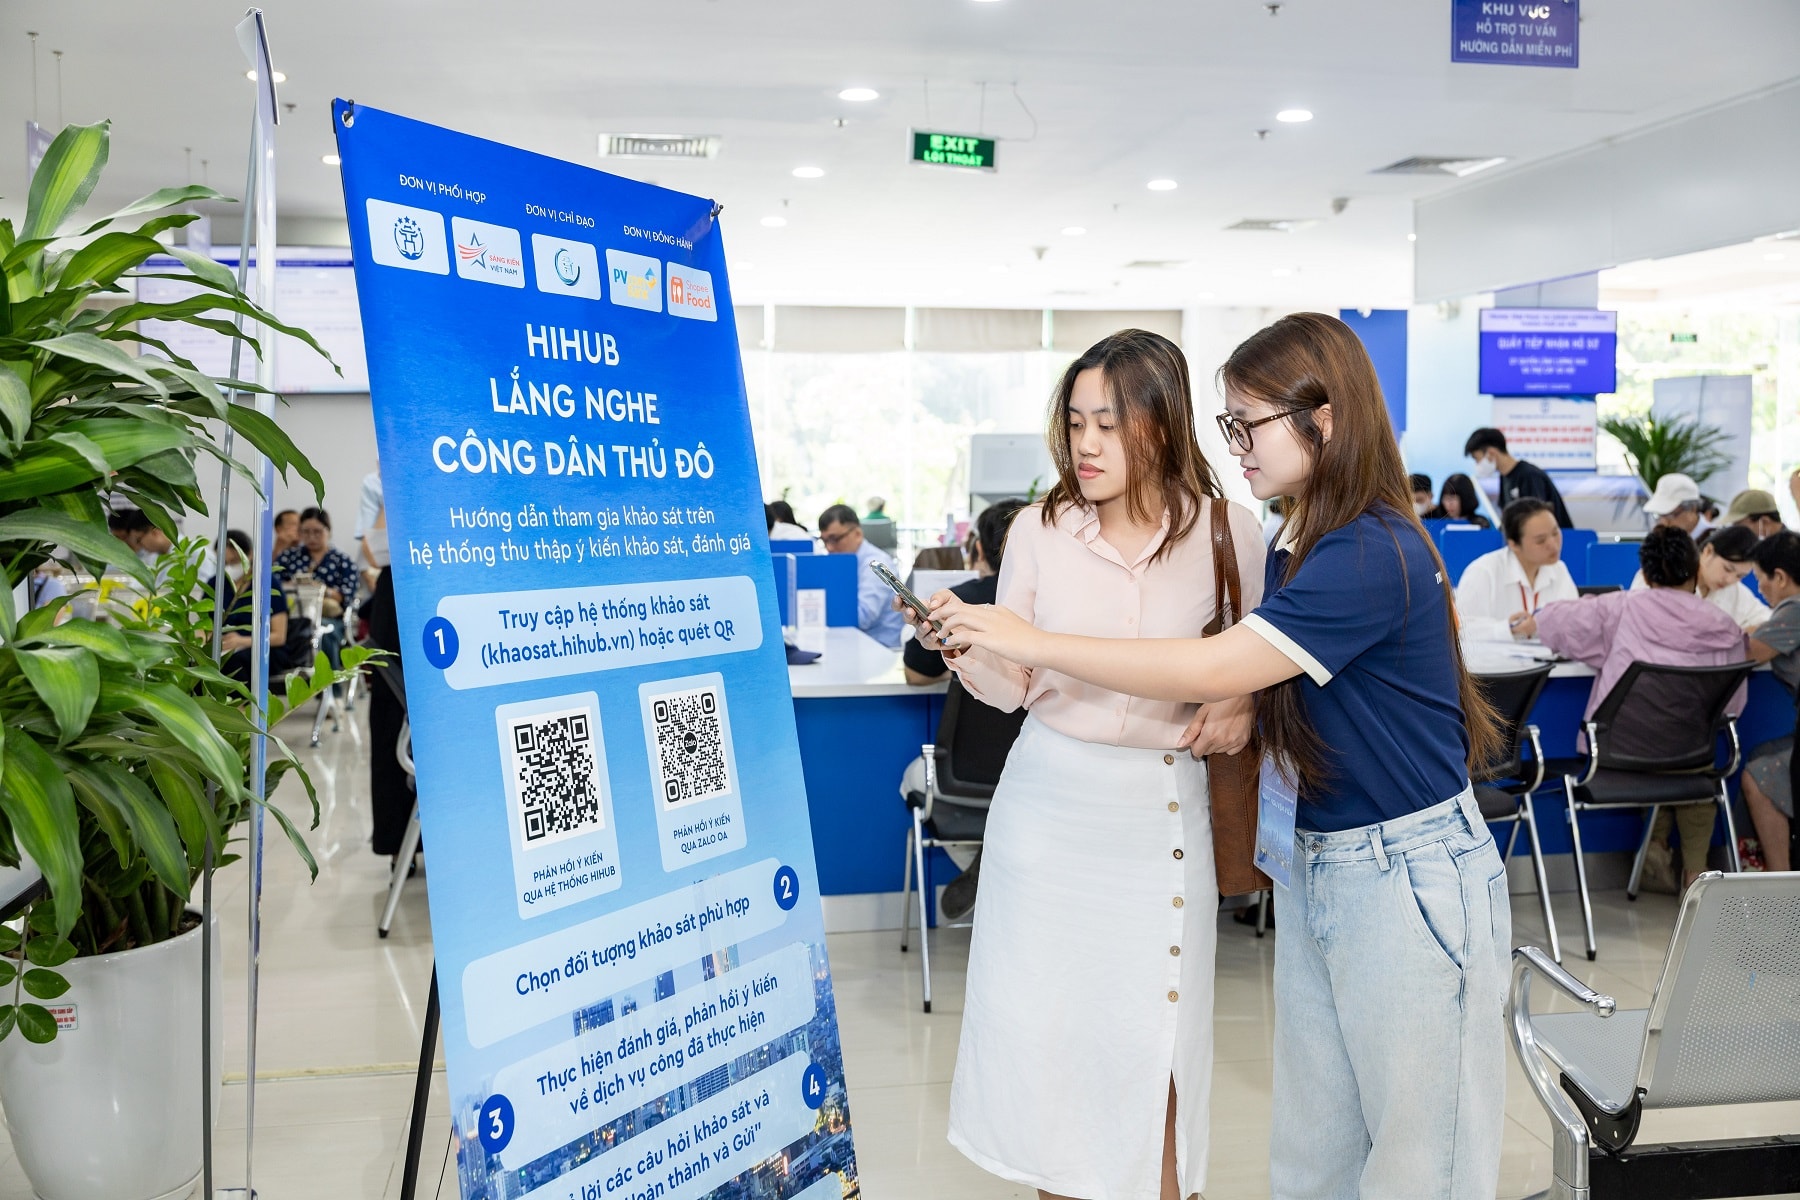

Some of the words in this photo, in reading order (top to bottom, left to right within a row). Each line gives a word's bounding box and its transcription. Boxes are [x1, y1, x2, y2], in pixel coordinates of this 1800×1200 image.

[1482, 3, 1514, 16] KHU
[1495, 22, 1516, 38] TRỢ
[1519, 24, 1534, 36] TƯ
[1535, 22, 1557, 37] VẤN
[1526, 40, 1552, 56] MIỄN
[1555, 43, 1572, 57] PHÍ
[930, 134, 979, 153] EXIT
[399, 174, 424, 190] ĐƠN
[426, 180, 437, 195] VỊ
[438, 183, 463, 199] PHỐI
[465, 190, 487, 205] HỢP
[526, 203, 546, 218] ĐƠN
[548, 208, 557, 222] VỊ
[576, 215, 595, 228] ĐẠO
[623, 225, 642, 238] ĐƠN
[643, 229, 652, 242] VỊ
[504, 267, 518, 275] NAM
[685, 280, 709, 294] Shopee
[686, 292, 711, 309] Food
[525, 323, 620, 366] HIHUB
[489, 365, 576, 418] LẮNG
[584, 386, 660, 425] NGHE
[432, 428, 537, 475] CÔNG
[544, 434, 606, 478] DÂN
[611, 437, 667, 479] THỦ
[674, 441, 714, 479] ĐÔ
[449, 507, 512, 532] Hướng
[517, 503, 548, 528] dẫn
[552, 505, 592, 527] tham
[597, 508, 620, 530] gia
[622, 505, 658, 527] khảo
[662, 507, 684, 526] sát
[686, 507, 715, 525] trên
[409, 541, 433, 570] hệ
[438, 538, 495, 567] thống
[500, 538, 530, 561] thu
[534, 538, 571, 564] thập
[576, 540, 585, 563] ý
[589, 535, 621, 558] kiến
[624, 535, 660, 557] khảo
[663, 536, 689, 558] sát,
[691, 532, 726, 554] đánh
[729, 531, 751, 554] giá
[498, 609, 538, 632] Truy
[544, 605, 574, 630] cập
[577, 602, 598, 627] hệ
[601, 597, 647, 621] thống
[650, 594, 685, 616] khảo
[689, 593, 711, 612] sát
[434, 628, 446, 655] 1
[480, 629, 635, 669] (khaosat.hihub.vn)
[639, 626, 674, 650] hoặc
[678, 622, 711, 645] quét
[713, 619, 736, 642] QR
[673, 824, 693, 839] PHẢN
[709, 817, 713, 828] Ý
[714, 812, 731, 827] KIẾN
[681, 840, 697, 854] QUA
[697, 834, 716, 848] ZALO
[717, 831, 728, 841] OA
[533, 865, 558, 882] PHẢN
[577, 856, 582, 868] Ý
[584, 850, 603, 867] KIẾN
[523, 889, 543, 904] QUA
[544, 882, 557, 897] HỆ
[557, 874, 589, 892] THỐNG
[590, 865, 616, 881] HIHUB
[780, 875, 793, 900] 2
[516, 967, 560, 996] Chọn
[564, 951, 589, 977] đối
[592, 939, 636, 967] tượng
[638, 923, 673, 949] khảo
[675, 913, 697, 936] sát
[699, 902, 724, 931] phù
[726, 896, 750, 920] hợp
[536, 1065, 577, 1096] Thực
[580, 1050, 613, 1077] hiện
[617, 1028, 653, 1059] đánh
[656, 1017, 682, 1046] giá,
[684, 1002, 716, 1034] phản
[719, 989, 739, 1013] hồi
[742, 984, 749, 1007] ý
[752, 972, 778, 998] kiến
[569, 1088, 589, 1115] về
[593, 1077, 624, 1106] dịch
[628, 1066, 646, 1088] vụ
[650, 1051, 684, 1077] công
[688, 1036, 704, 1059] đã
[706, 1023, 736, 1051] thực
[739, 1010, 765, 1035] hiện
[809, 1074, 820, 1096] 4
[488, 1107, 504, 1139] 3
[606, 1167, 633, 1192] các
[637, 1149, 663, 1174] câu
[667, 1130, 690, 1158] hỏi
[693, 1115, 728, 1144] khảo
[731, 1101, 752, 1123] sát
[754, 1089, 770, 1109] và
[667, 1152, 710, 1189] thành
[713, 1141, 730, 1163] và
